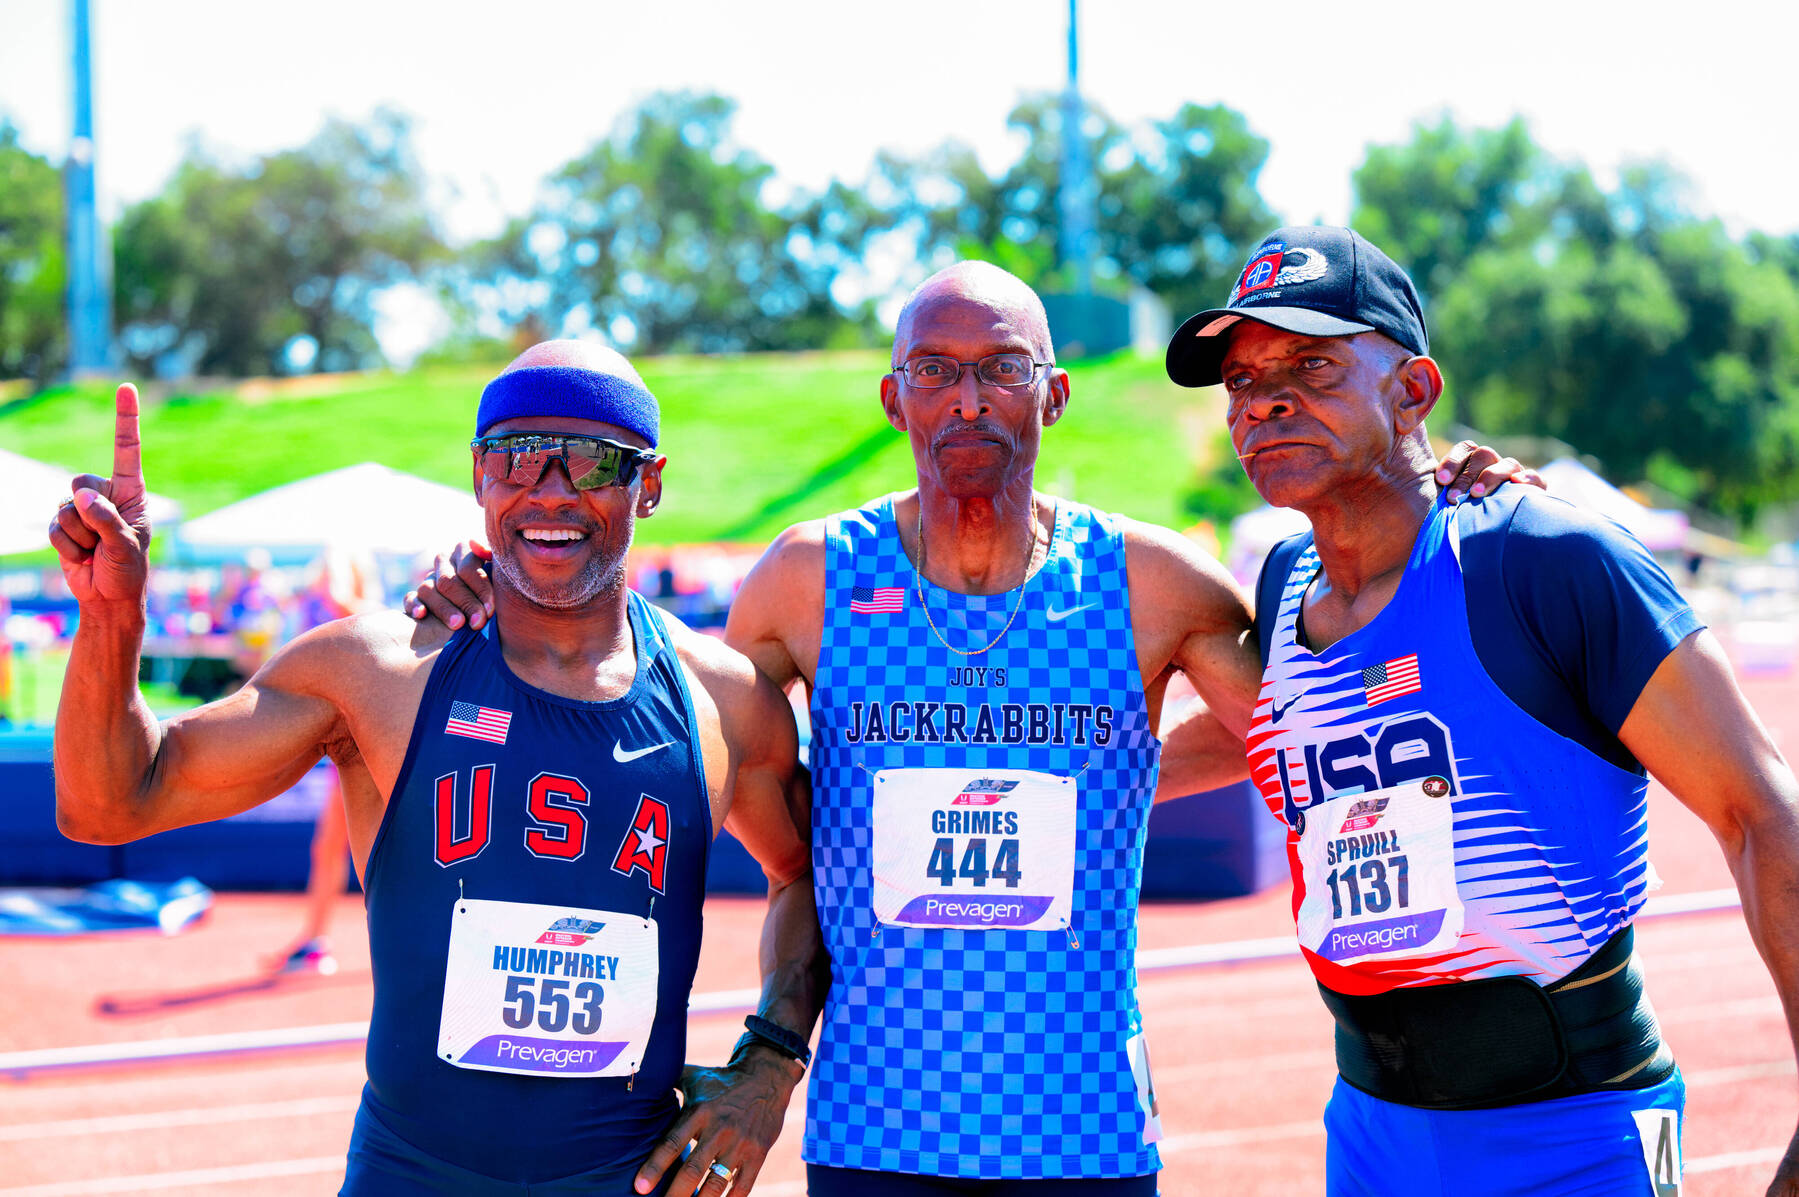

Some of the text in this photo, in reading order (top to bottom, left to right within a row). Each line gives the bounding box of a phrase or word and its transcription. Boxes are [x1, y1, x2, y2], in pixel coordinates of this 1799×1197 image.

[1240, 291, 1281, 306] AIRBORNE
[950, 667, 1006, 687] JOY'S
[845, 701, 1114, 746] JACKRABBITS
[1276, 711, 1462, 827] USA
[434, 763, 672, 896] USA
[931, 810, 1018, 835] GRIMES
[926, 838, 1022, 888] 444
[1327, 829, 1401, 866] SPRUILL
[1326, 854, 1409, 920] 1137
[926, 899, 1021, 922] Prevagen
[1332, 923, 1417, 951] Prevagen
[493, 945, 620, 981] HUMPHREY
[502, 975, 606, 1035] 553
[497, 1039, 595, 1068] Prevagen
